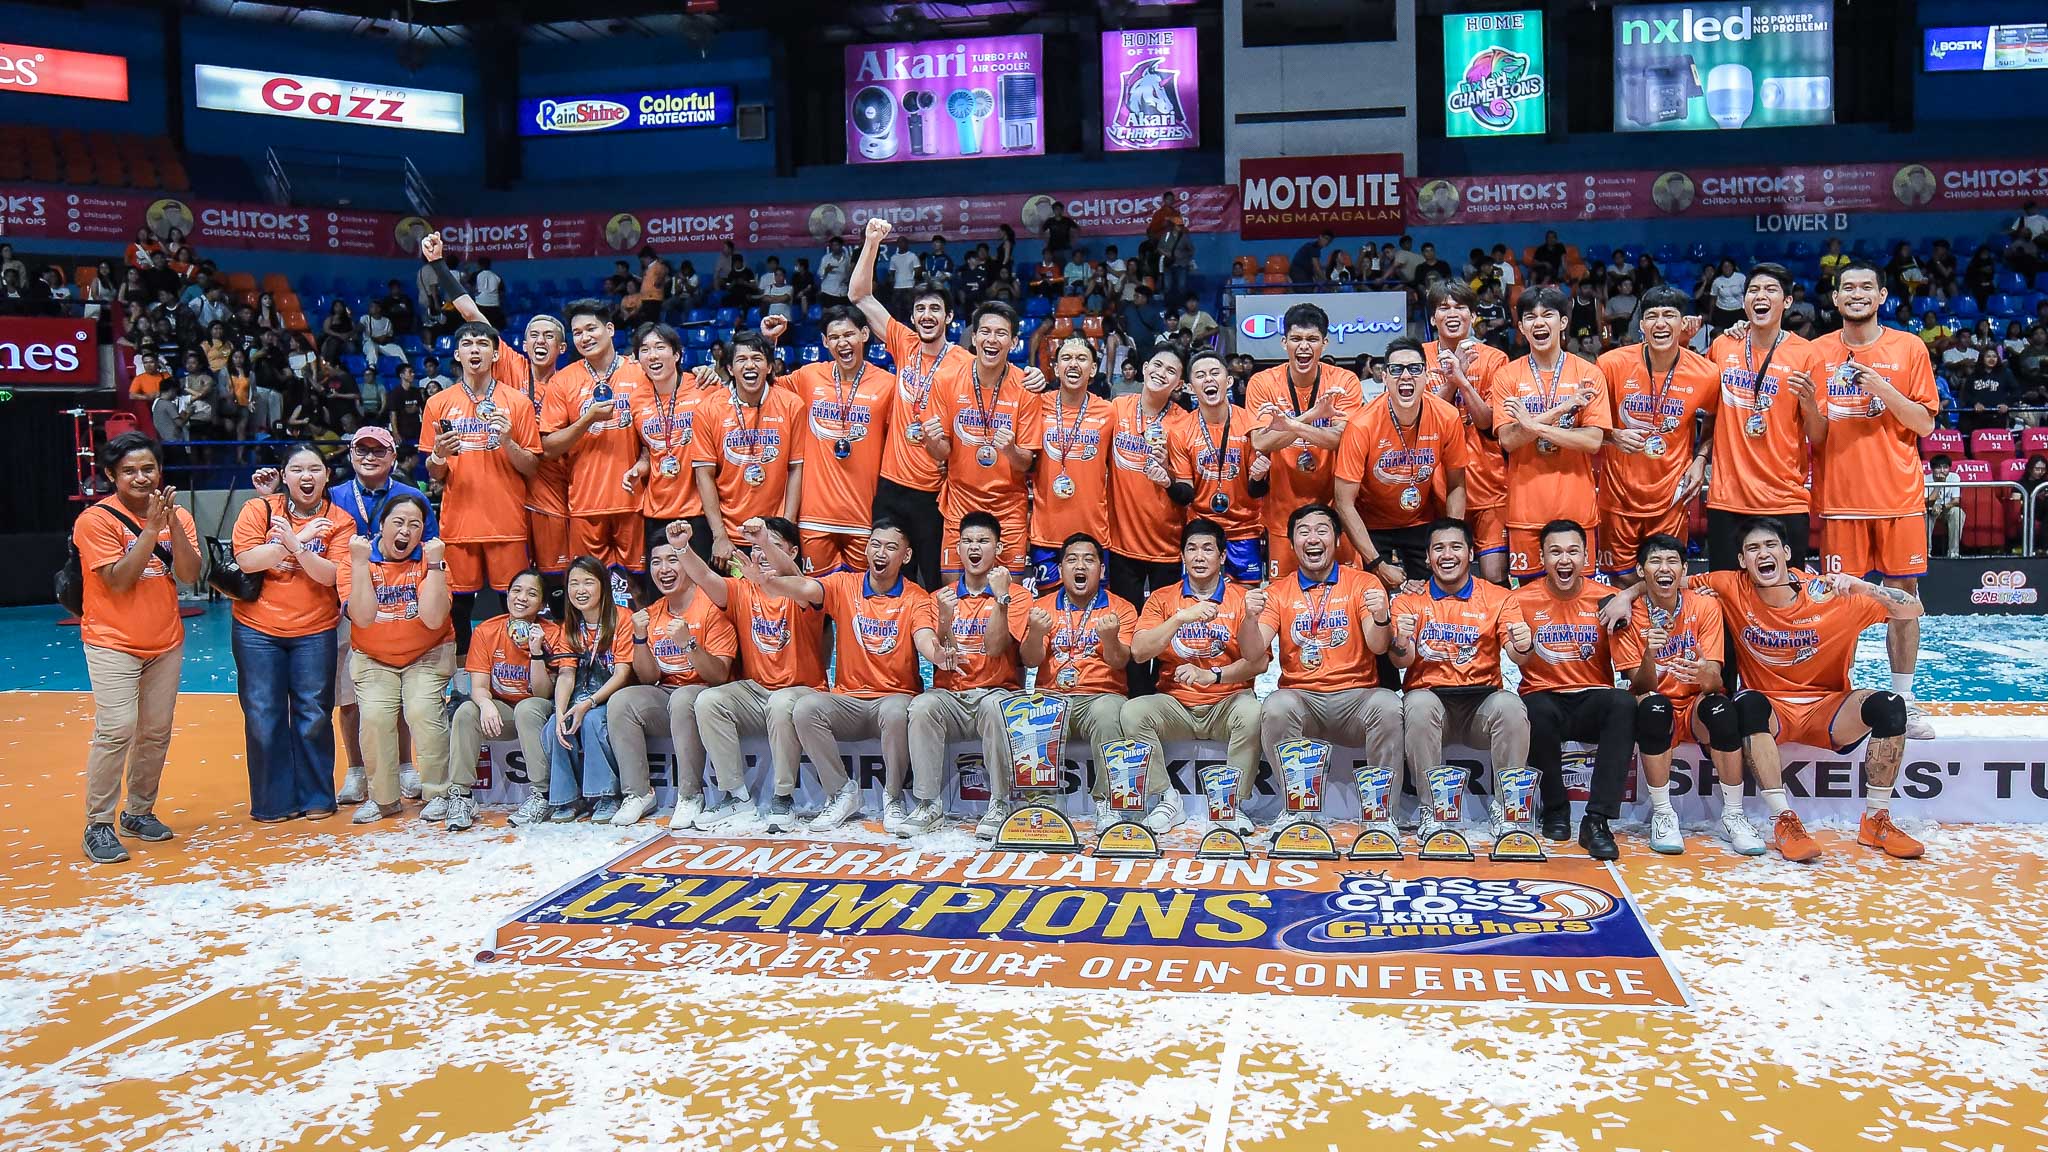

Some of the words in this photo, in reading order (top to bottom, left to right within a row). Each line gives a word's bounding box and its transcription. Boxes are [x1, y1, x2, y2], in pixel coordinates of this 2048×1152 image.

[1465, 14, 1524, 31] HOME
[1622, 7, 1752, 45] nxled
[1753, 16, 1769, 25] NO
[1771, 14, 1813, 24] POWER?
[1753, 25, 1769, 33] NO
[1772, 22, 1828, 33] PROBLEM!
[1123, 32, 1174, 46] HOME
[1940, 40, 1982, 51] BOSTIK
[971, 53, 1005, 62] TURBO
[1007, 51, 1028, 60] FAN
[1148, 47, 1170, 55] THE
[856, 44, 967, 82] Akari
[972, 64, 989, 73] AIR
[991, 62, 1030, 72] COOLER
[1461, 72, 1507, 93] nxled
[261, 77, 405, 123] Gazz
[639, 92, 715, 113] Colorful
[1450, 78, 1541, 109] CHAMELEONS
[639, 110, 715, 125] PROTECTION
[1126, 111, 1176, 127] Akari
[1116, 126, 1185, 139] CHARGERS
[1702, 174, 1805, 195] CHITOK'S
[1943, 168, 2048, 189] CHITOK'S
[1243, 173, 1400, 211] MOTOLITE
[1466, 181, 1567, 204] CHITOK'S
[201, 208, 309, 232] CHITOK'S
[647, 213, 734, 234] CHITOK'S
[852, 204, 944, 225] CHITOK'S
[1245, 209, 1401, 224] PANGMATAGALAN
[1756, 213, 1828, 232] LOWER
[1834, 213, 1848, 231] B
[442, 222, 529, 243] CHITOK'S
[1929, 432, 1961, 442] Akari
[1978, 432, 2012, 441] Akari
[1955, 463, 1989, 473] Akari
[1509, 552, 1527, 570] 23
[1825, 554, 1842, 573] 16
[1537, 631, 1598, 643] CHAMPIONS
[1744, 629, 1819, 648] CHAMPIONS
[646, 842, 1320, 888] CONGRATULATIONS
[560, 877, 1273, 942] CHAMPIONS
[1327, 919, 1592, 938] Crunchers
[1079, 957, 1230, 984] OPEN
[1255, 962, 1653, 997] CONFERENCE
